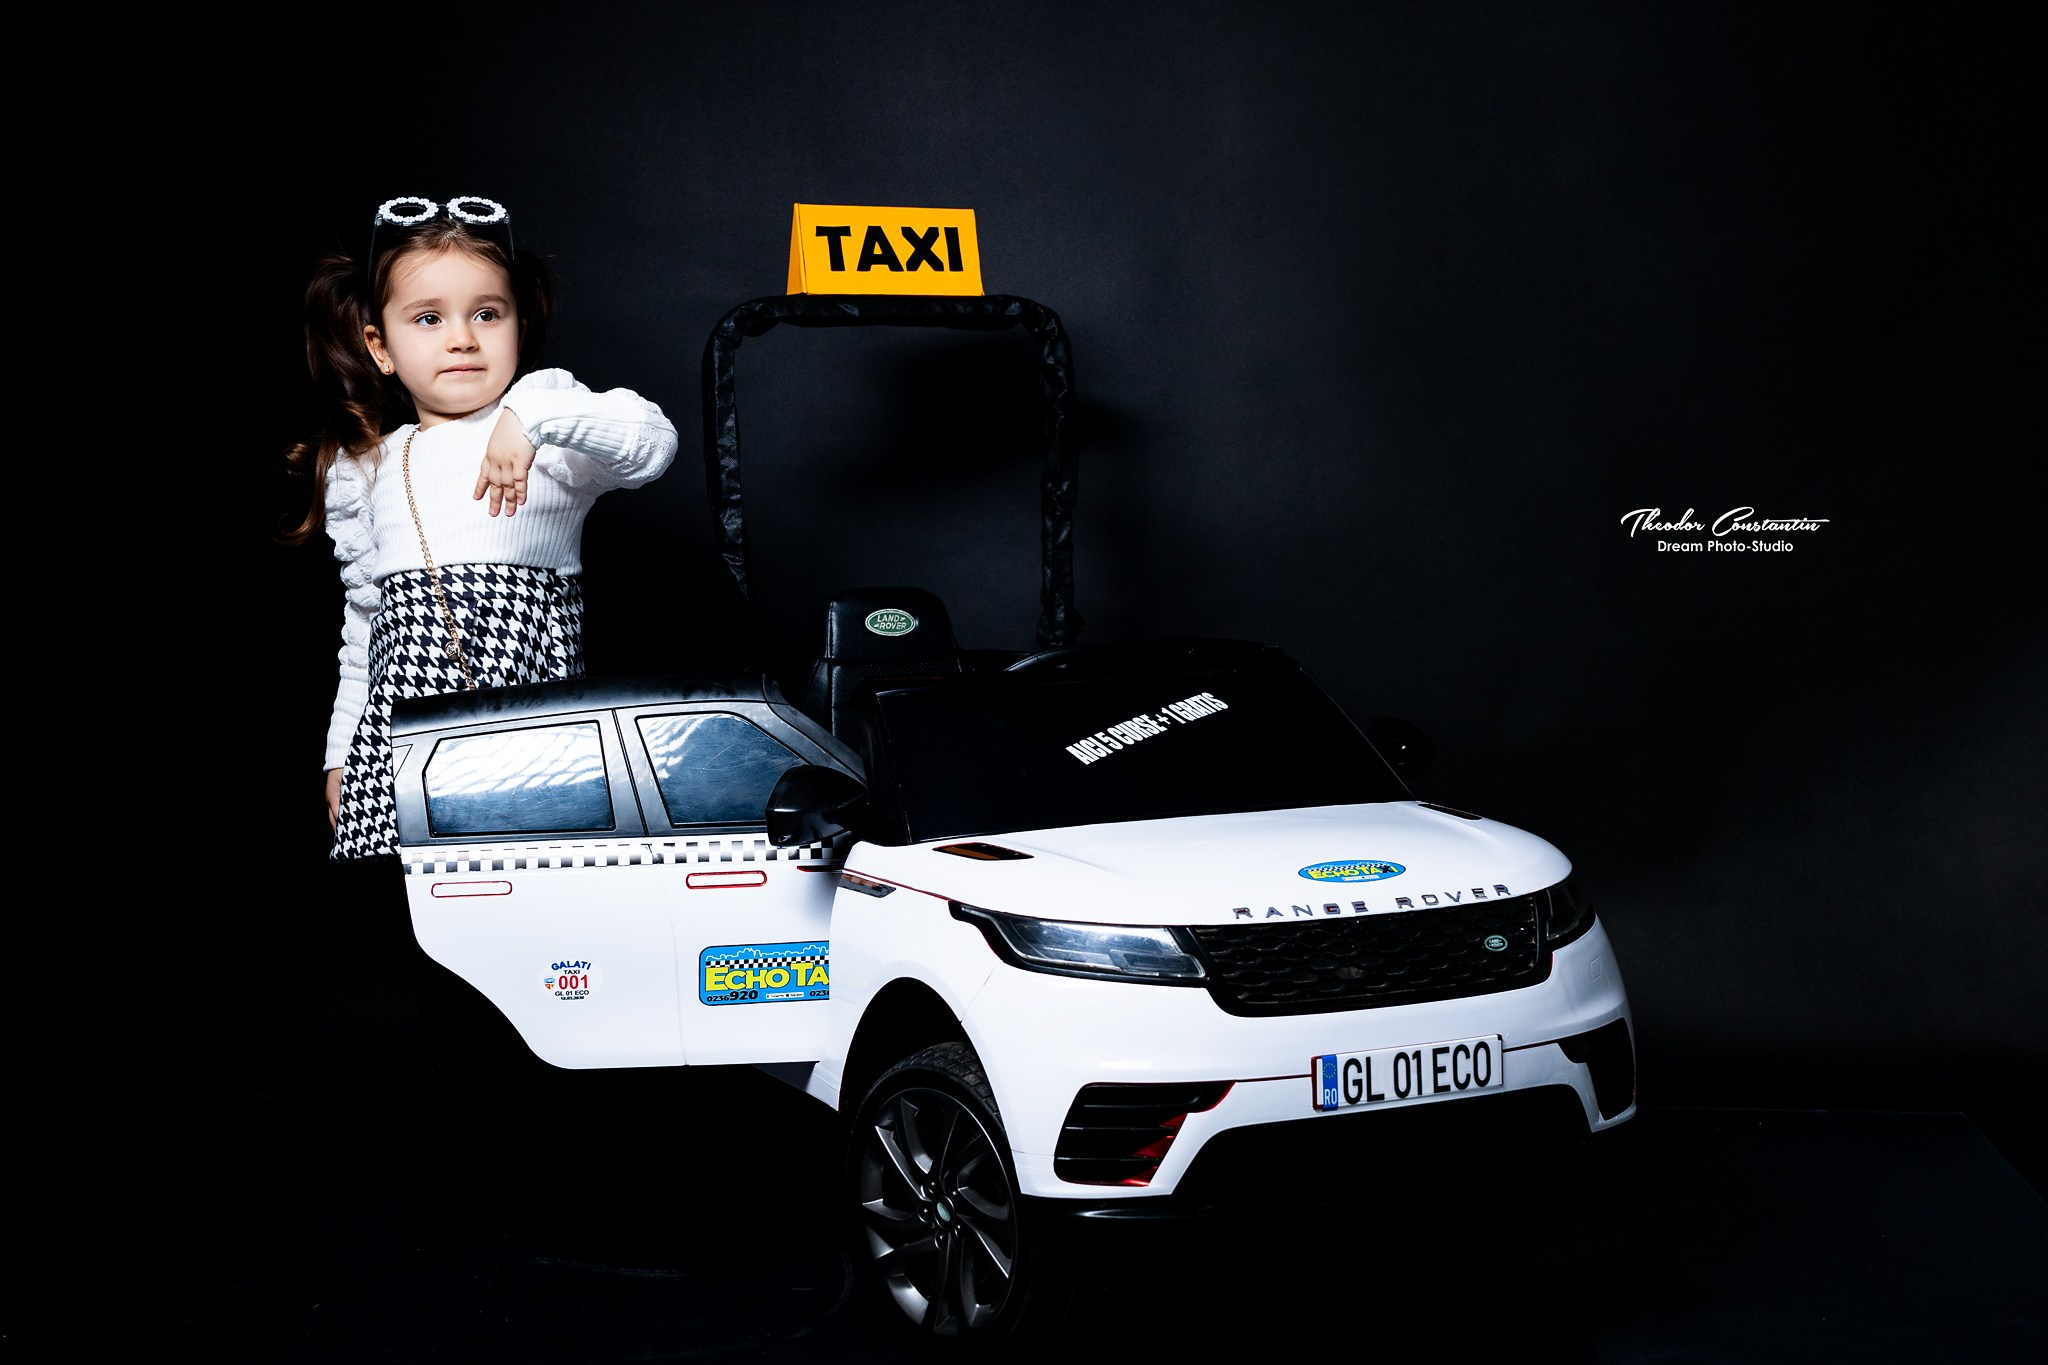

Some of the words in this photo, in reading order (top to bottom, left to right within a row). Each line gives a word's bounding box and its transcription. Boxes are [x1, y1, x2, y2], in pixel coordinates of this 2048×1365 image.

[815, 225, 964, 272] TAXI
[877, 614, 900, 622] LAND
[879, 622, 907, 630] ROVER
[1161, 707, 1187, 724] 1
[1168, 692, 1229, 721] GRATIS
[1107, 713, 1168, 745] CURSE
[1094, 731, 1124, 750] 5
[1065, 736, 1114, 765] AICI
[1308, 869, 1359, 879] ECHO
[1356, 865, 1399, 875] TAXI
[1232, 900, 1369, 920] RANGE
[1394, 884, 1511, 909] ROVER
[551, 960, 592, 971] GALATI
[558, 974, 588, 990] 001
[705, 966, 791, 992] ECHO
[1342, 1056, 1385, 1105] GL
[1393, 1050, 1423, 1099] 01
[1432, 1041, 1492, 1093] ECO
[1324, 1087, 1338, 1106] RO
